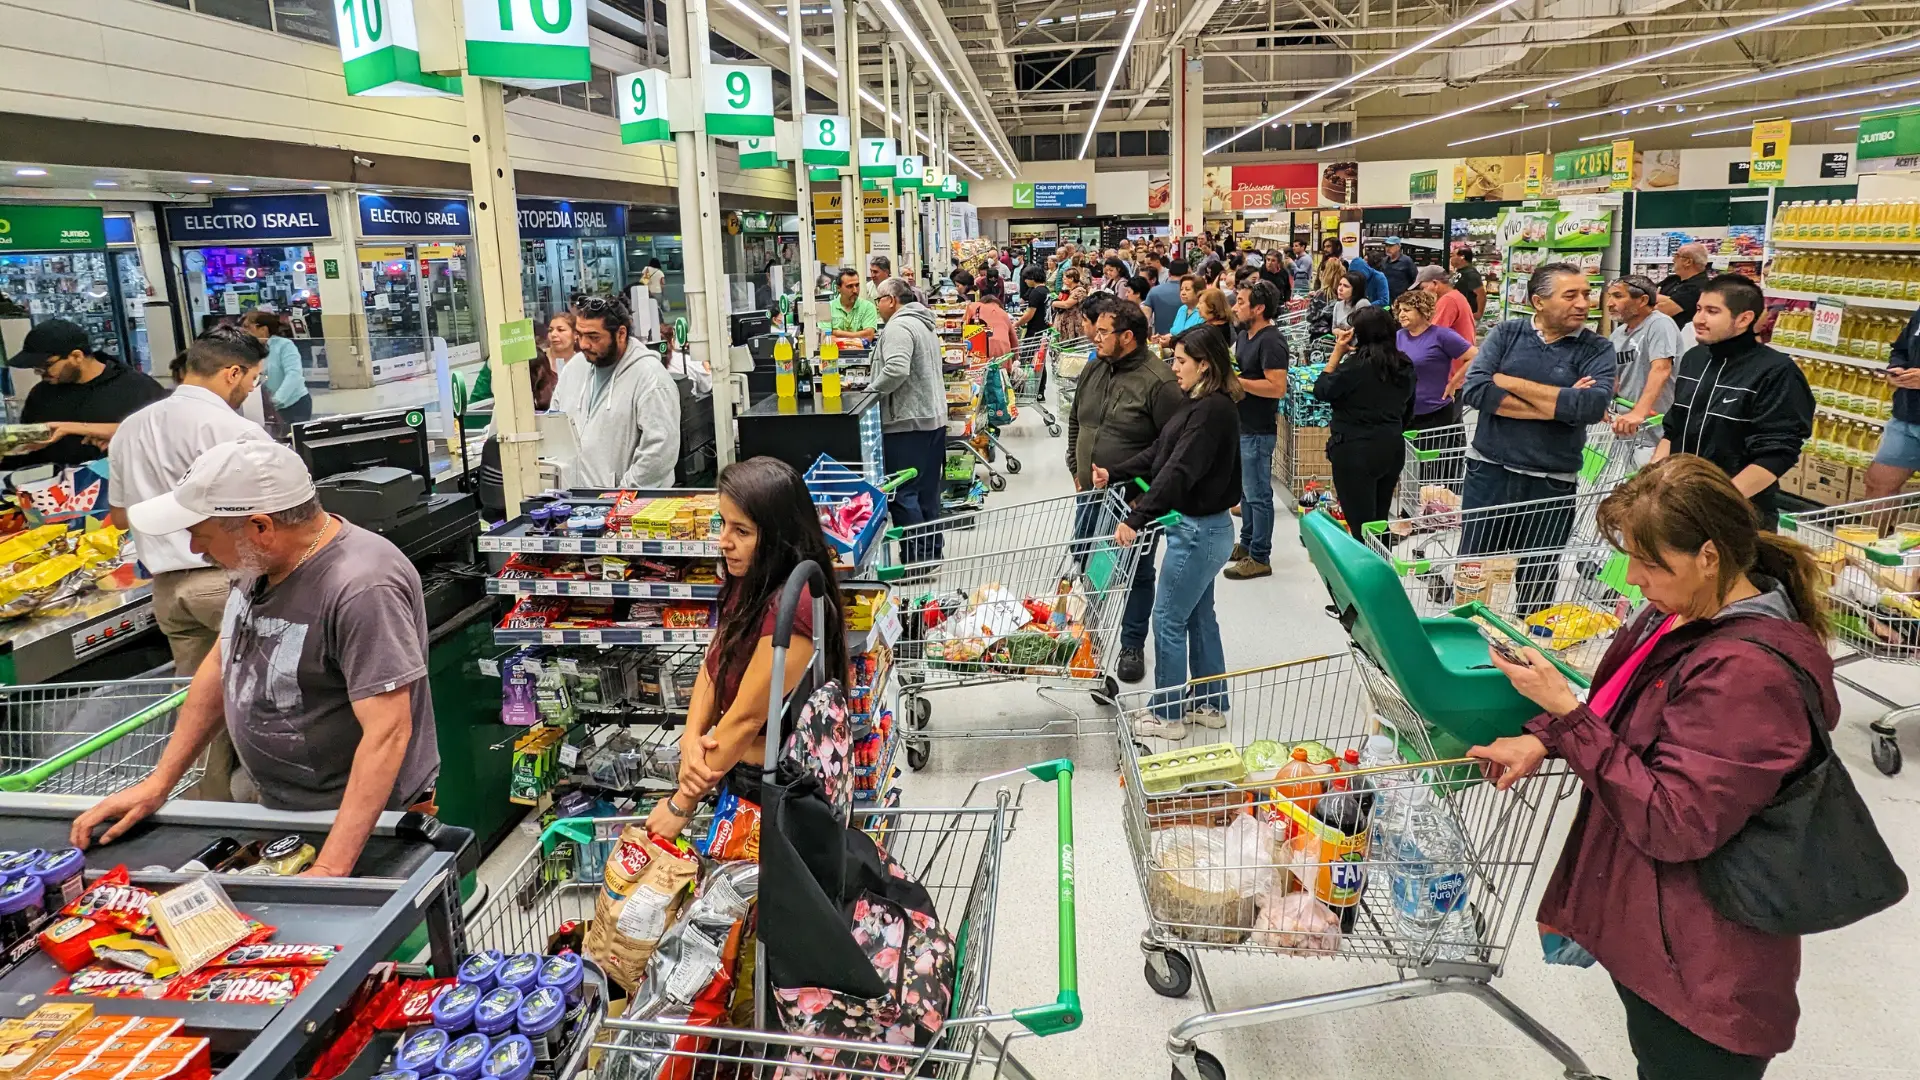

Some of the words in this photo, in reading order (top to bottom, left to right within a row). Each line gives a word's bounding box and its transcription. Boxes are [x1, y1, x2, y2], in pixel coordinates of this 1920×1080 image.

[631, 78, 647, 116] 9
[725, 71, 751, 109] 9
[818, 118, 836, 146] 8
[1861, 131, 1895, 144] JUMBO
[871, 141, 885, 163] 7
[902, 158, 914, 175] 6
[925, 169, 935, 184] 5
[942, 177, 949, 190] 4
[956, 182, 962, 194] 3
[1243, 189, 1310, 210] pasles
[184, 213, 257, 231] ELECTRO
[262, 212, 319, 228] ISRAEL
[370, 207, 422, 225] ELECTRO
[424, 211, 460, 226] ISRAEL
[516, 209, 572, 229] RTOPEDIA
[573, 210, 608, 228] ISRAEL
[60, 230, 90, 238] JUMBO
[1815, 309, 1840, 325] 3.099
[411, 414, 418, 423] 8
[623, 843, 649, 865] Marco
[624, 853, 642, 872] Polo
[33, 1009, 72, 1021] Werther's
